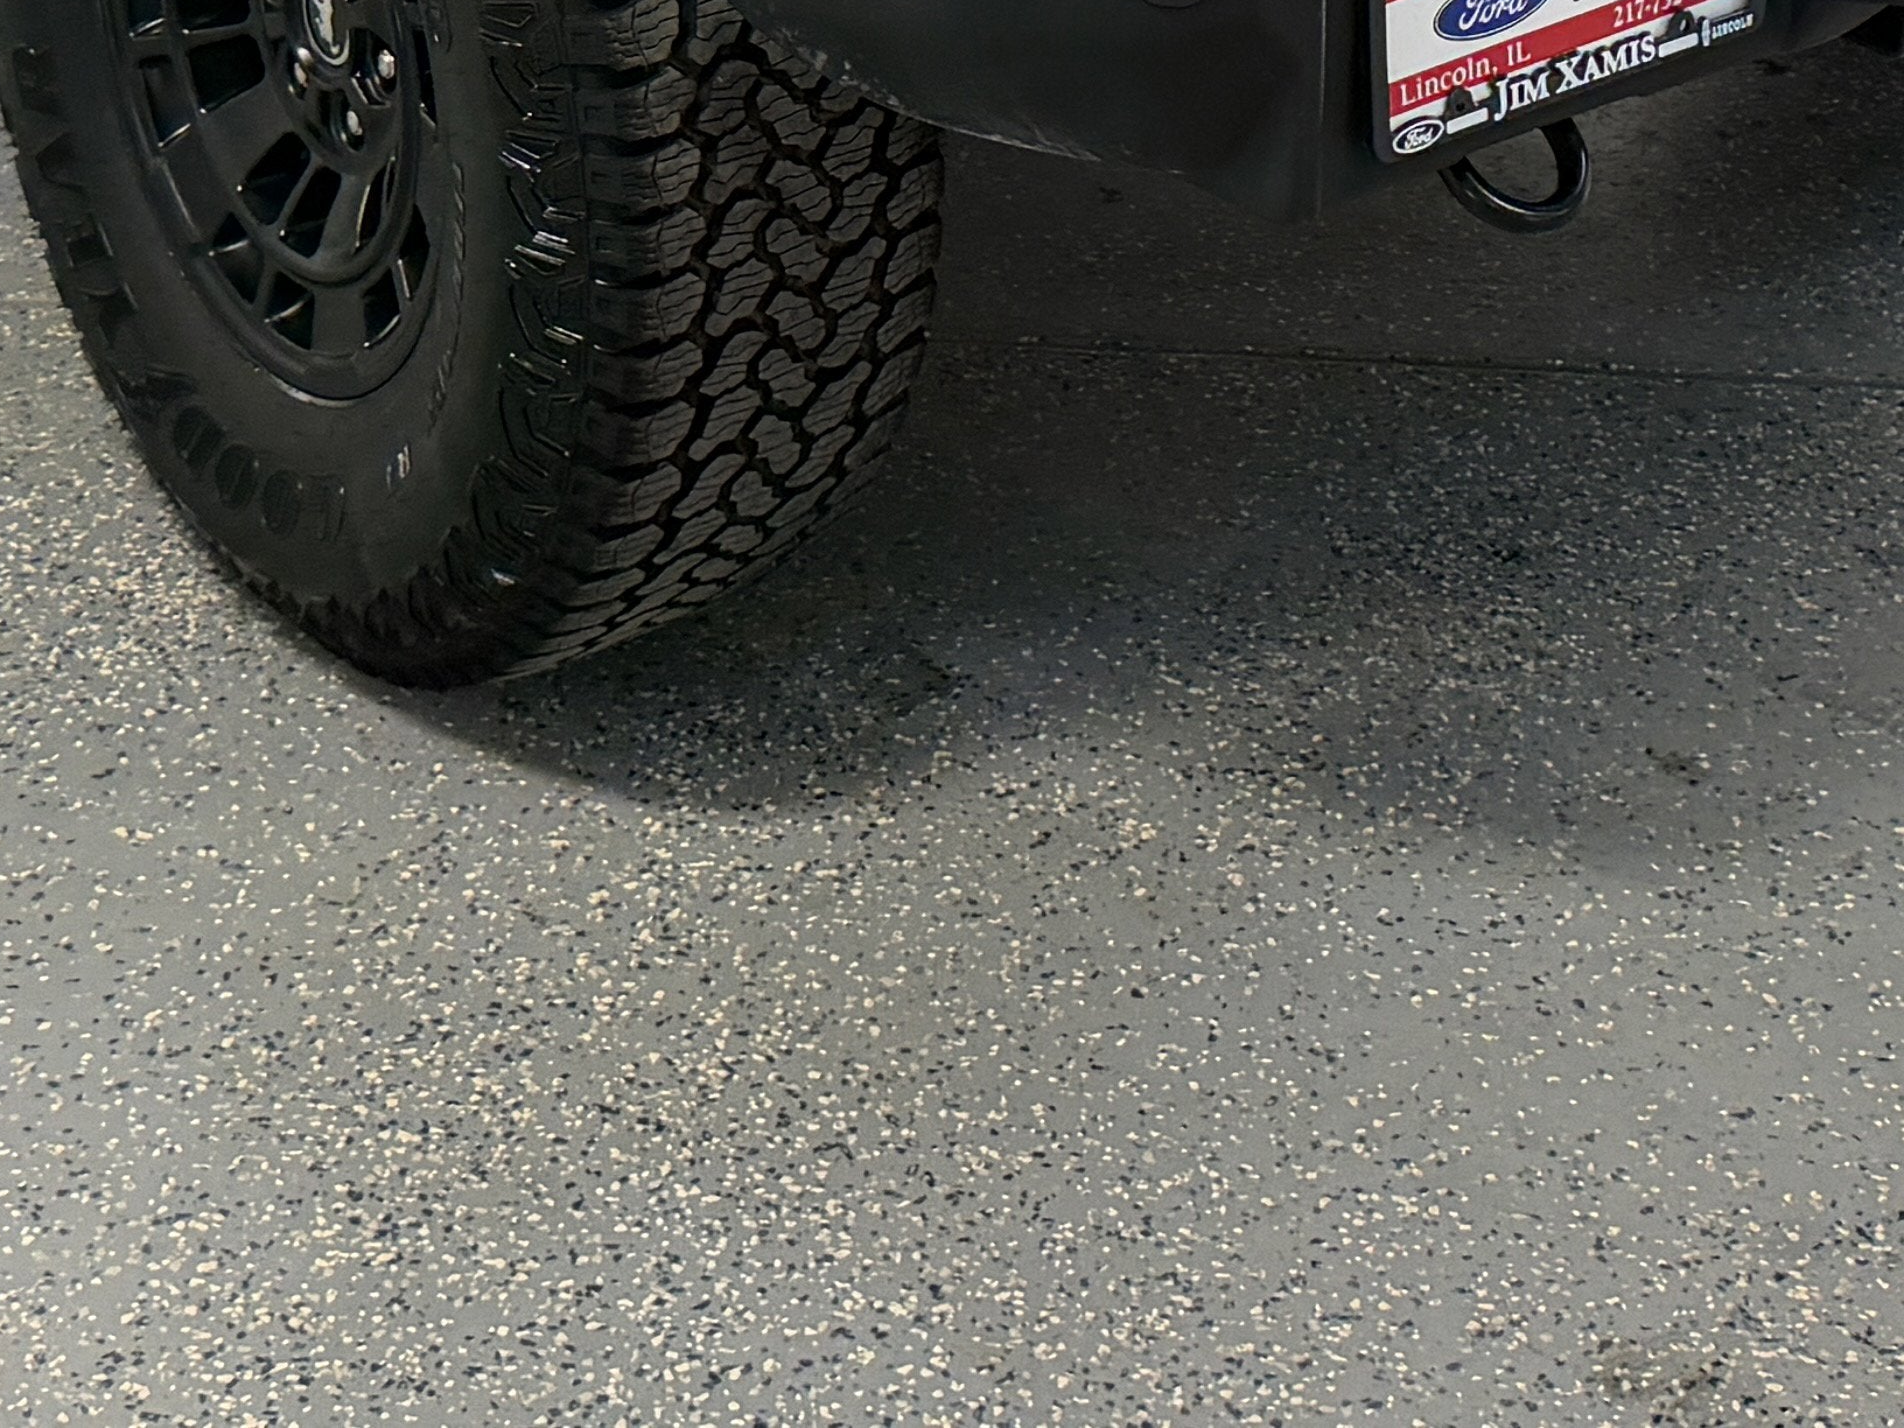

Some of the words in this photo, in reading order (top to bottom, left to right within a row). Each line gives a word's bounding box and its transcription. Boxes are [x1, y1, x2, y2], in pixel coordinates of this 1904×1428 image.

[1506, 40, 1532, 66] IL
[1493, 71, 1550, 121] JIM
[1555, 34, 1659, 94] XAMIS
[1404, 129, 1436, 150] Ford
